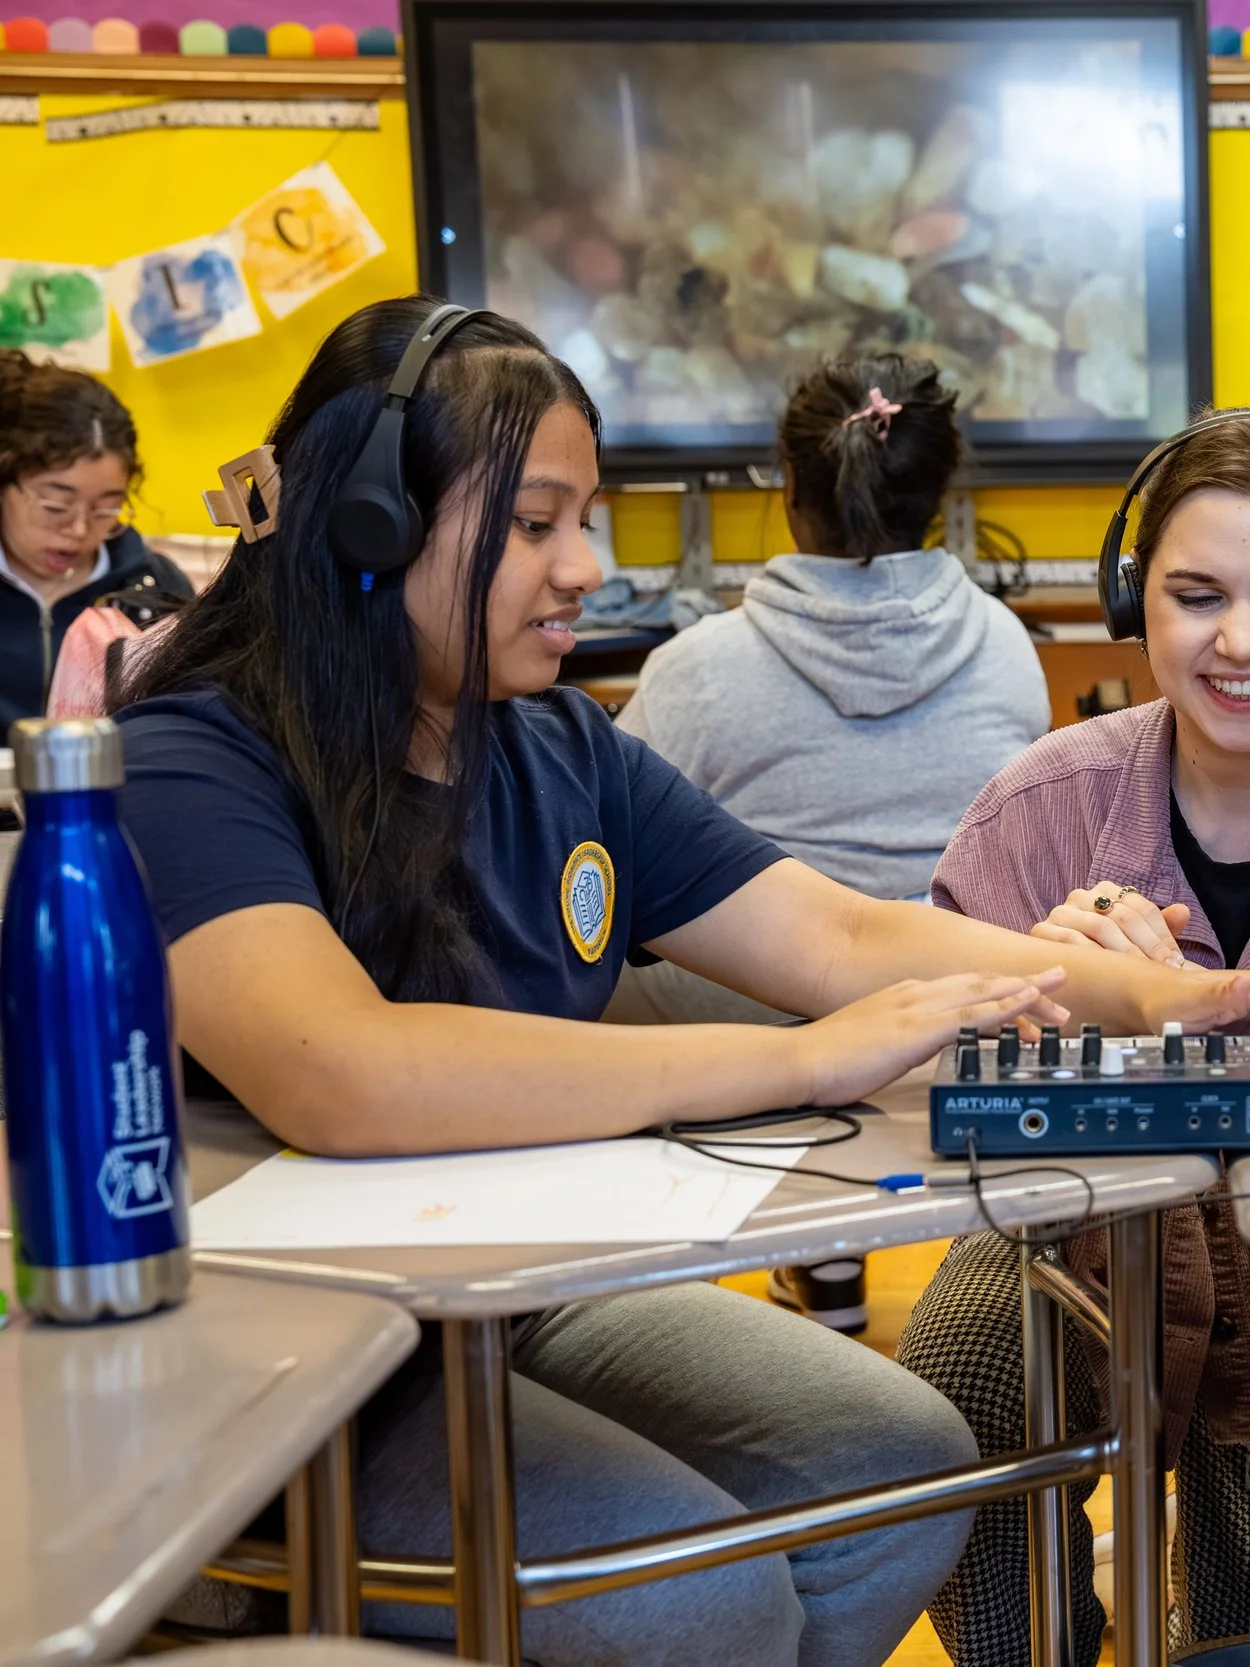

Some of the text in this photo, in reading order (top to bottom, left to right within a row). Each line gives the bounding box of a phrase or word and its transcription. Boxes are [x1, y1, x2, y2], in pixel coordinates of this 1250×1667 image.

[21, 278, 51, 327] S
[272, 207, 316, 253] C
[945, 1096, 1023, 1110] ARTURIA
